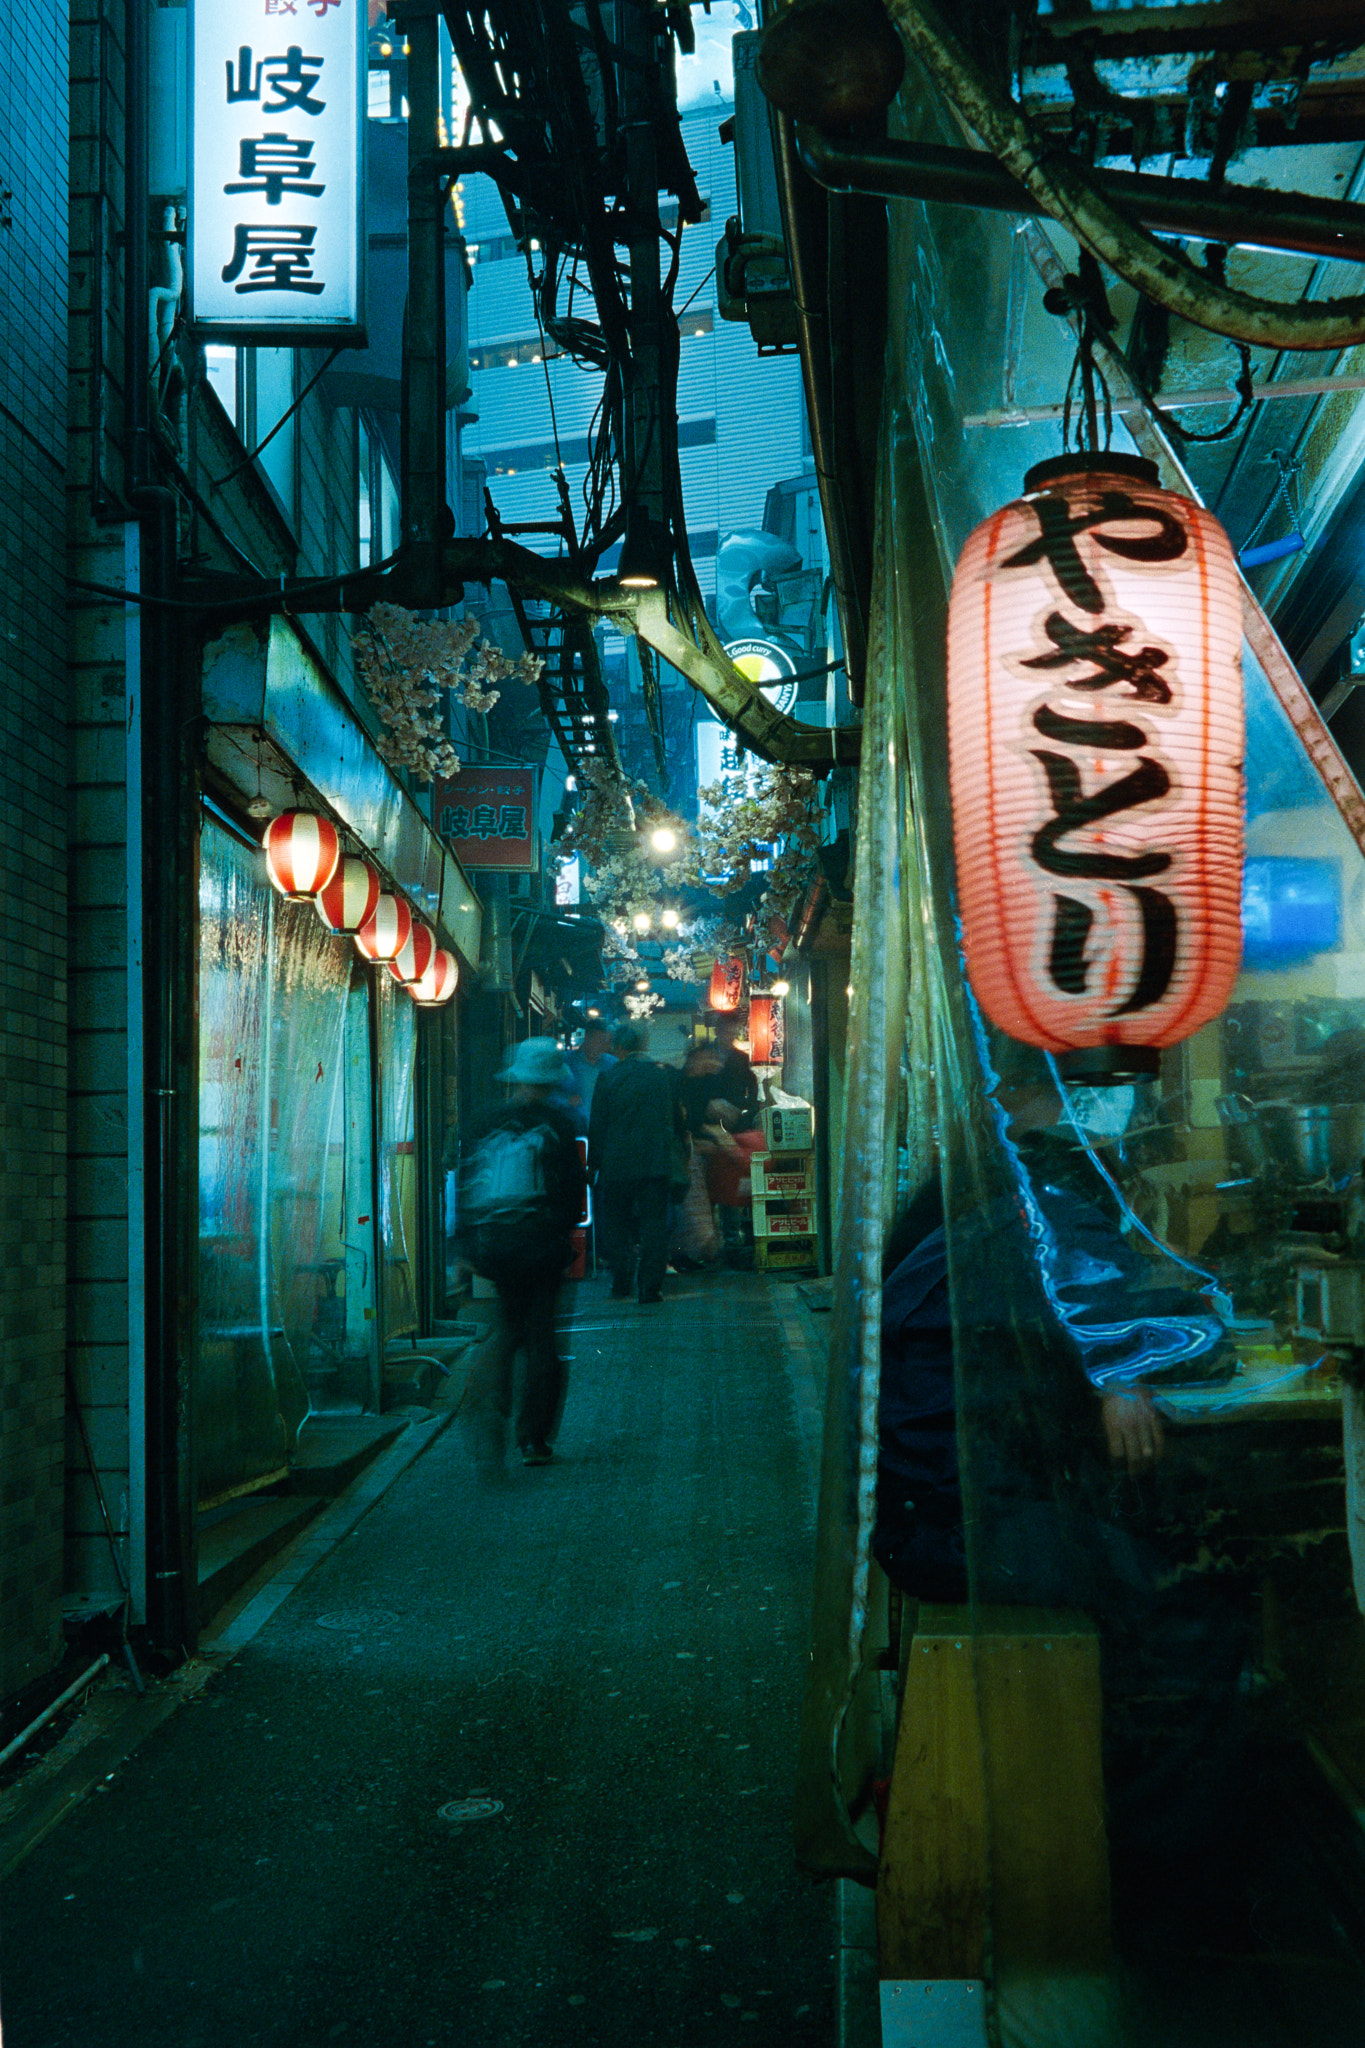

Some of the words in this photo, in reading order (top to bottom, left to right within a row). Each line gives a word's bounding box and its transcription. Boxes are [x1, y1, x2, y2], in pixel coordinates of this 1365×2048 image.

[221, 45, 327, 296] 岐阜屋
[731, 643, 752, 656] Good
[752, 645, 772, 657] curry
[440, 803, 529, 841] 岐阜屋
[1000, 489, 1188, 1018] やきとり
